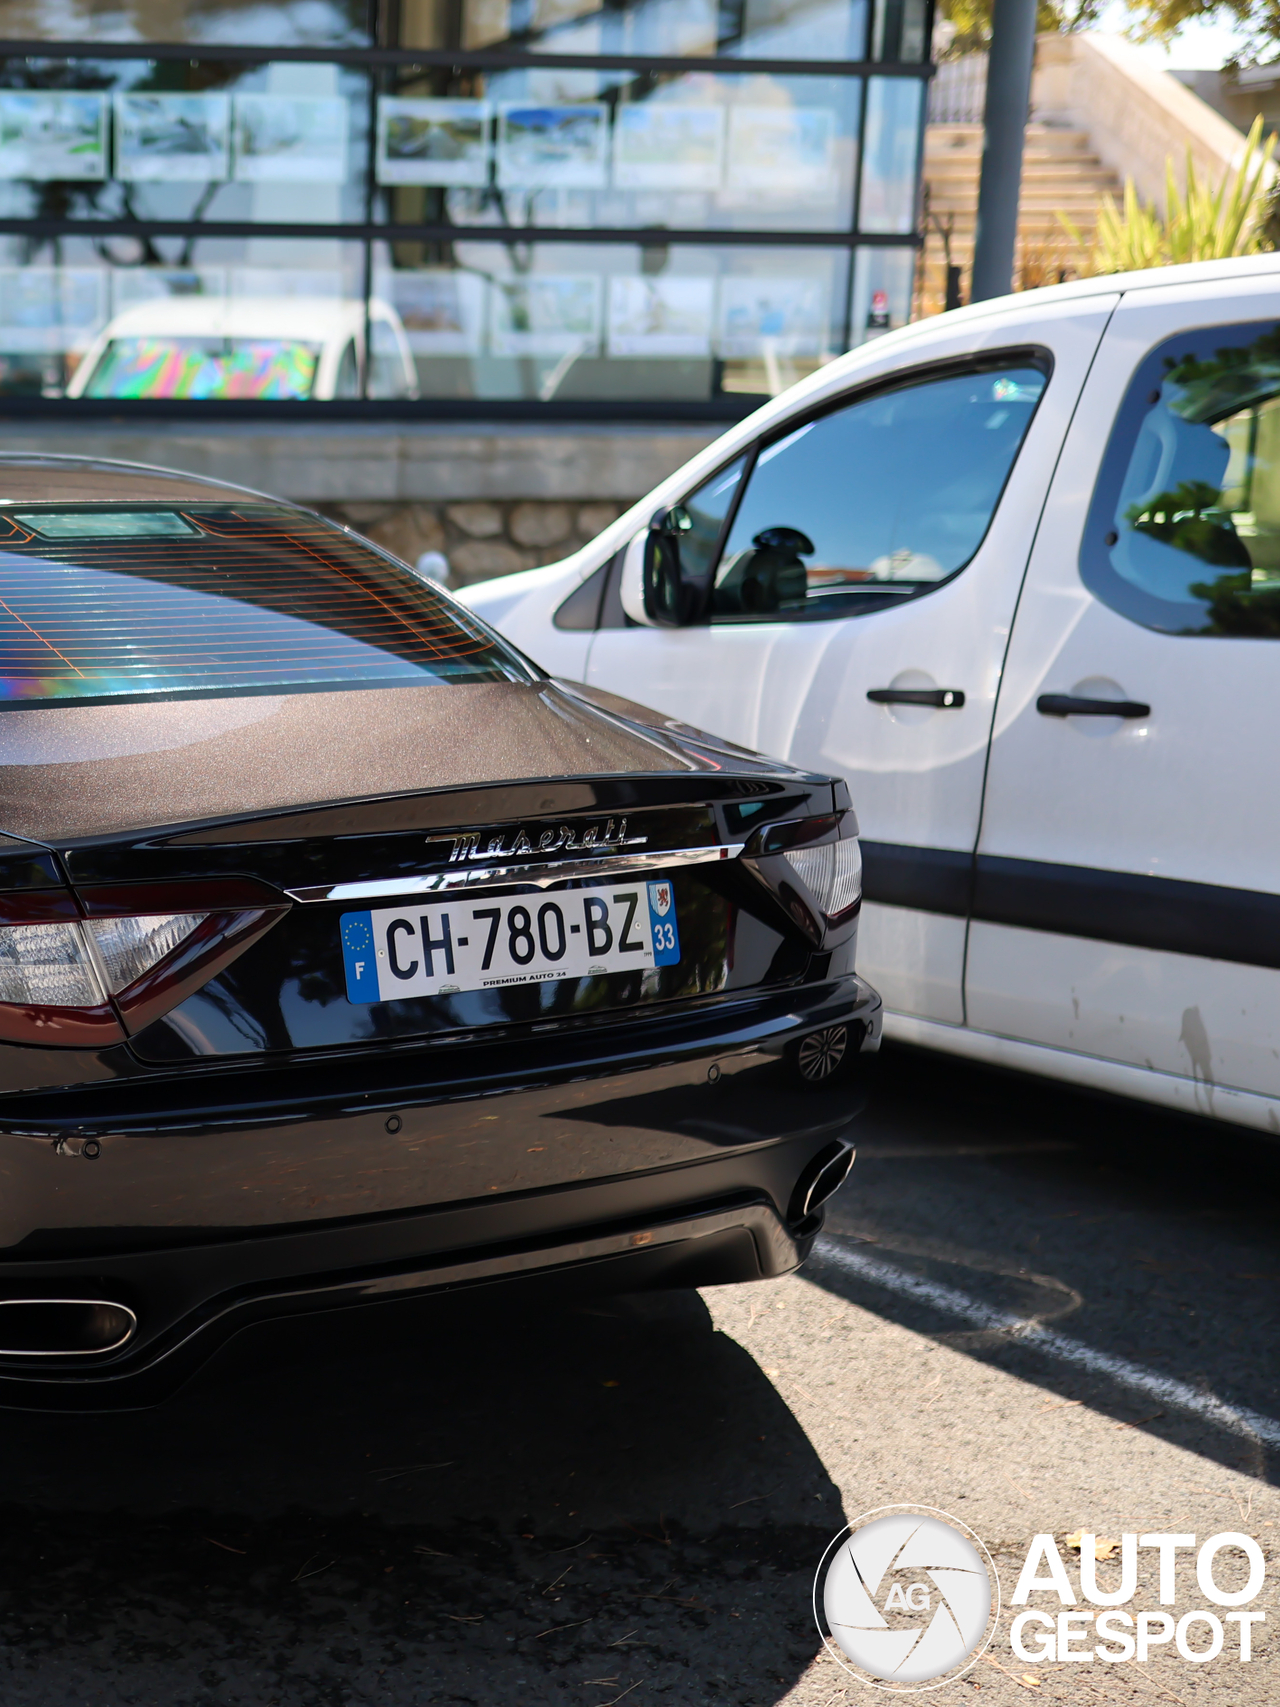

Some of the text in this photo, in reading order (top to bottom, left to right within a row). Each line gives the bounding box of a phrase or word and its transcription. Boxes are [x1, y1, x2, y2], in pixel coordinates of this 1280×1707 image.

[425, 818, 648, 863] Maserati
[385, 892, 644, 980] CH-780-BZ
[654, 923, 675, 951] 33
[355, 962, 365, 980] F
[483, 976, 527, 986] PREMIUM
[529, 973, 554, 981] AUTO
